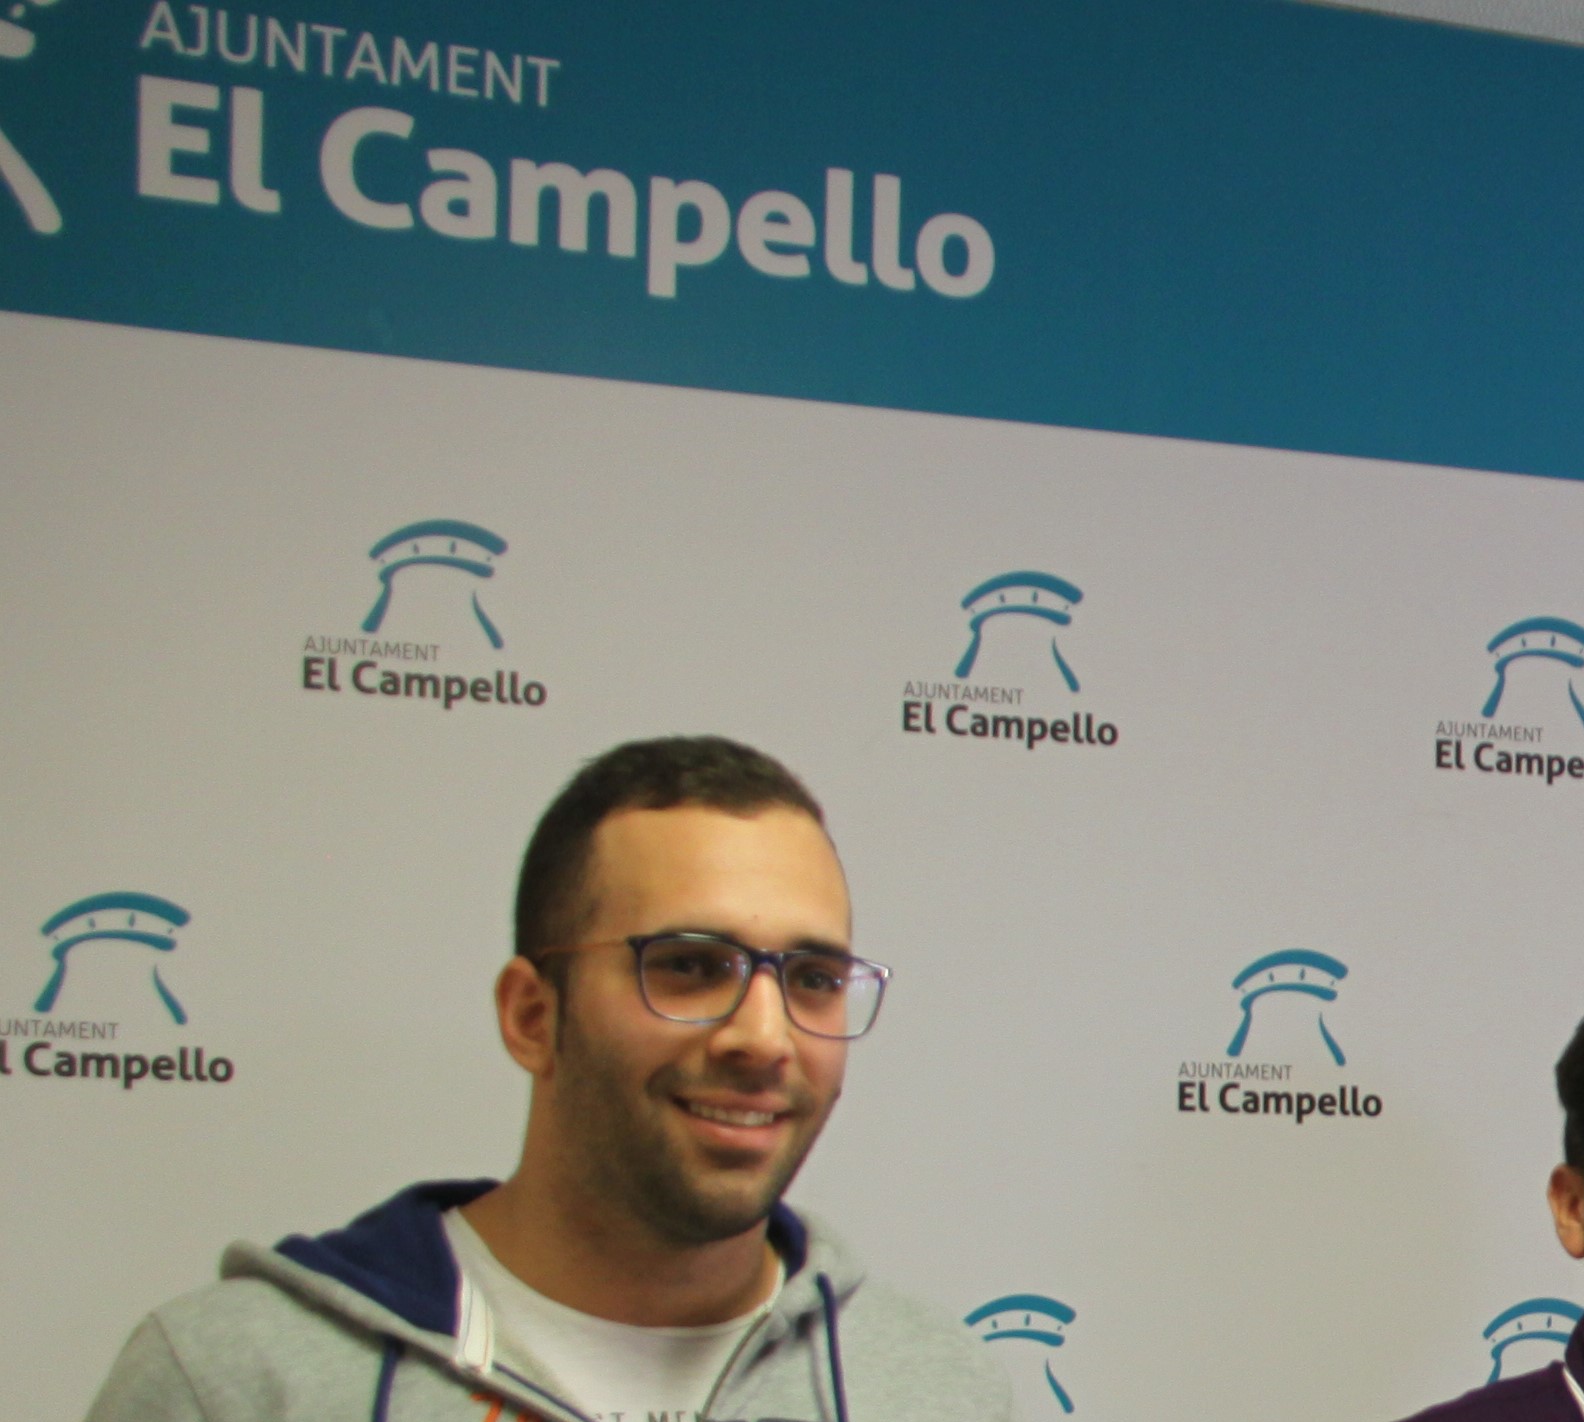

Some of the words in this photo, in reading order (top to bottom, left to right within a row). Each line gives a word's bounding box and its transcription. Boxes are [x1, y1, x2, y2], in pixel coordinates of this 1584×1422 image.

[139, 1, 560, 108] AJUNTAMENT
[137, 75, 281, 214] El
[319, 106, 996, 300] Campello
[304, 635, 440, 662] AJUNTAMENT
[303, 656, 340, 692] El
[352, 661, 547, 710] Campello
[904, 680, 1024, 706] AJUNTAMENT
[903, 701, 936, 735] El
[947, 703, 1118, 750] Campello
[1436, 719, 1544, 744] AJUNTAMENT
[1435, 739, 1465, 771] El
[0, 1019, 119, 1041] UNTAMENT
[24, 1040, 234, 1090] Campello
[1178, 1063, 1293, 1081] AJUNTAMENT
[1178, 1081, 1209, 1113] El
[1219, 1082, 1382, 1124] Campello
